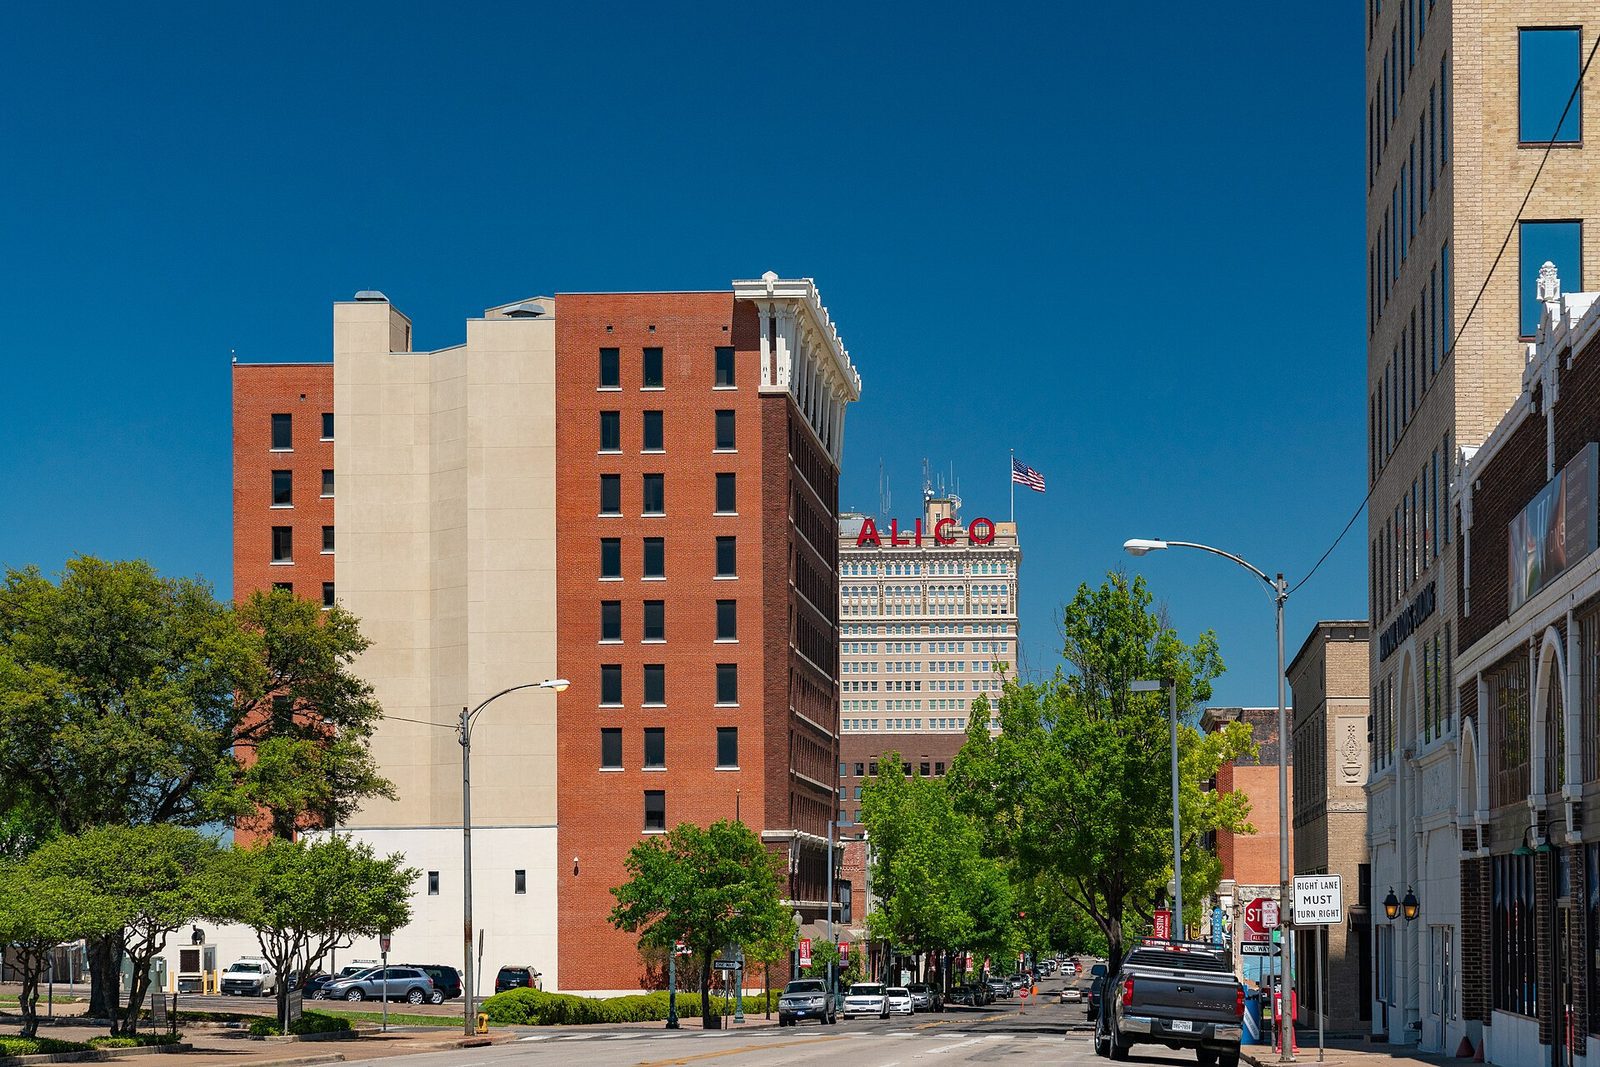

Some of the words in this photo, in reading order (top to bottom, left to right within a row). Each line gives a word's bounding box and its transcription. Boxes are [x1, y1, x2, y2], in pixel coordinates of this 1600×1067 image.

[856, 517, 995, 546] ALICO
[1297, 882, 1318, 890] RIGHT
[1320, 881, 1338, 890] LANE
[1303, 895, 1332, 905] MUST
[1247, 908, 1262, 922] ST
[1297, 910, 1316, 918] TURN
[1318, 909, 1339, 918] RIGHT
